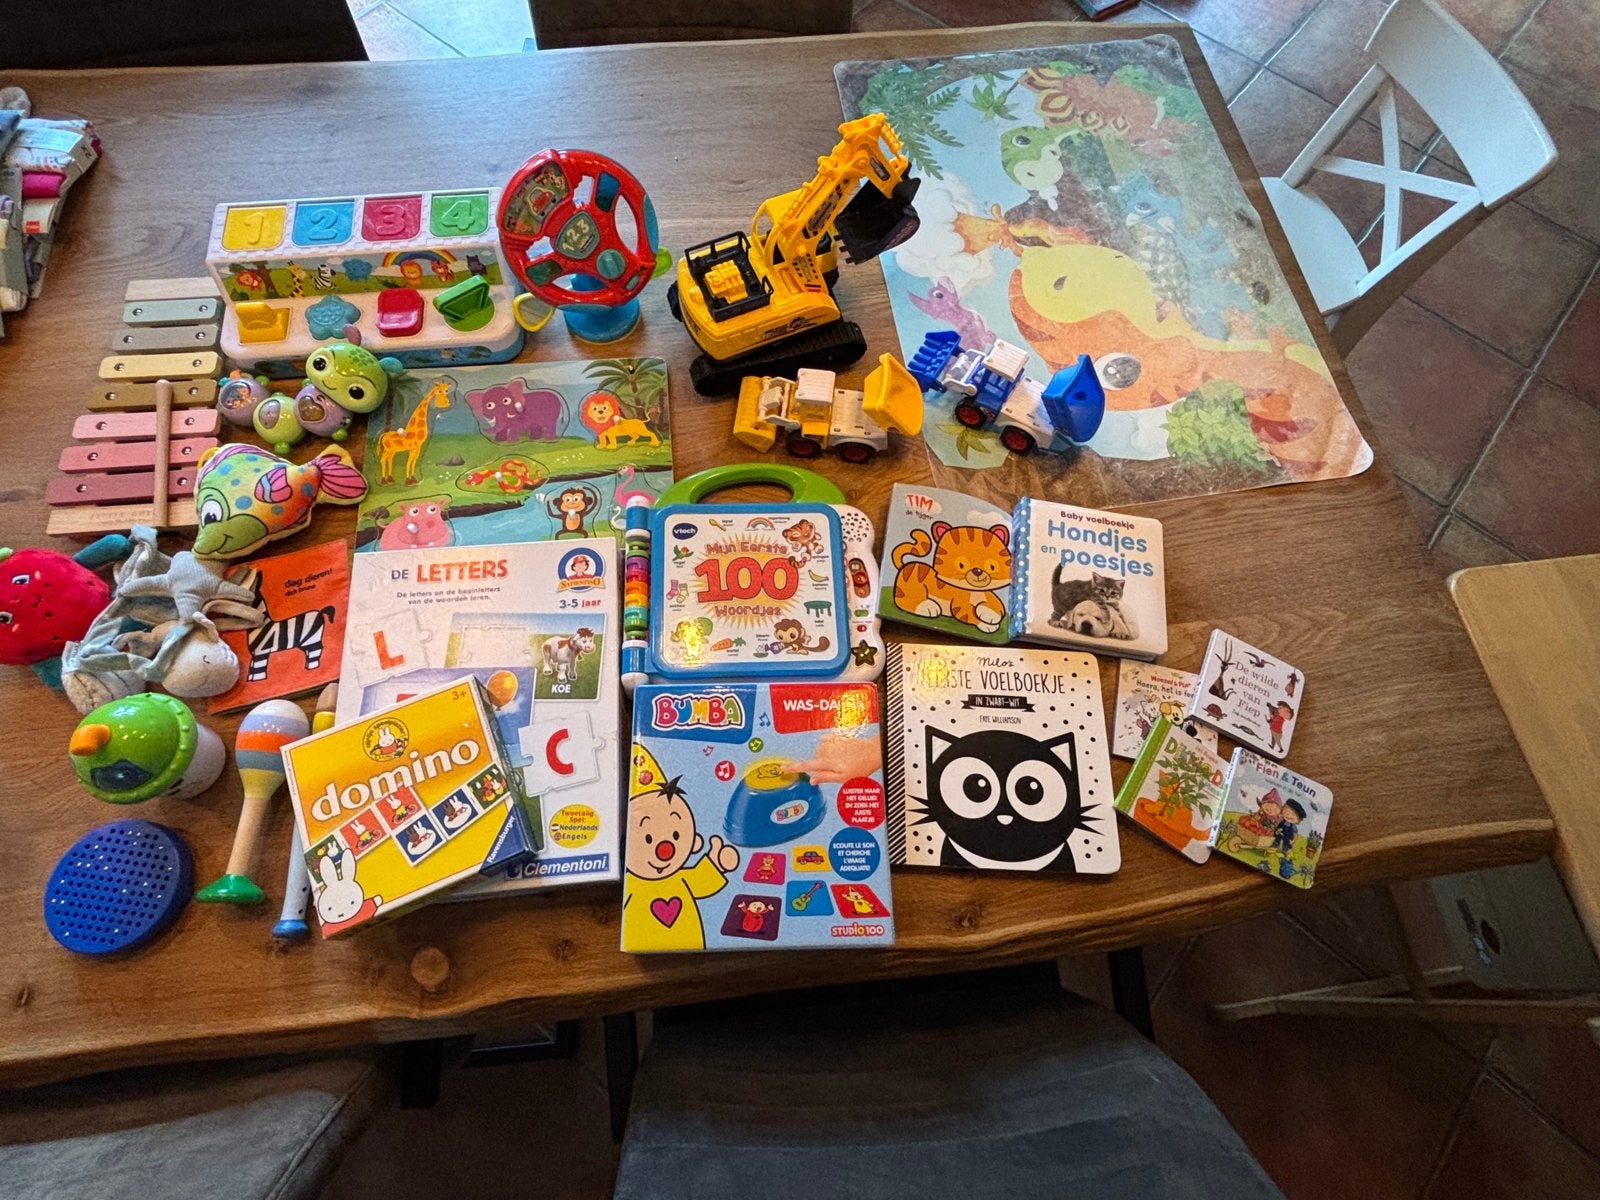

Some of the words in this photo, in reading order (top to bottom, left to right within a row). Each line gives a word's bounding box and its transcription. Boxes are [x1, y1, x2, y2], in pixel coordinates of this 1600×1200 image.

[308, 208, 338, 240] 2
[375, 203, 406, 235] 3
[441, 200, 475, 231] 4
[243, 212, 264, 244] 1
[906, 494, 933, 511] TIM
[1060, 510, 1083, 521] Baby
[1086, 517, 1135, 530] voelboekje
[1048, 519, 1147, 553] Hondjes
[391, 569, 409, 580] DE
[417, 559, 508, 583] LETTERS
[1041, 545, 1057, 554] en
[1060, 548, 1154, 577] poesjes
[284, 579, 303, 588] dag
[304, 567, 333, 583] dieren!
[694, 556, 799, 603] 100
[559, 599, 578, 609] 3-5
[582, 599, 601, 608] jaar
[715, 605, 781, 617] Woordjes
[373, 631, 405, 670] L
[980, 670, 1066, 693] VOELBOEKJE
[1235, 661, 1250, 675] De
[1252, 671, 1280, 690] wilde
[1238, 676, 1270, 698] dieren
[451, 690, 467, 701] 3+
[551, 684, 571, 694] KOE
[1161, 685, 1174, 694] het
[1242, 691, 1261, 706] van
[654, 695, 743, 730] BUMBA
[975, 697, 983, 705] IN
[1237, 699, 1261, 718] Fiep
[545, 727, 575, 776] C
[311, 739, 480, 821] domino
[1256, 762, 1280, 779] Fien
[1281, 771, 1290, 783] &
[1291, 775, 1317, 798] Teun
[486, 816, 516, 863] Ravensburger
[524, 856, 608, 876] Clementoni
[865, 924, 885, 936] 100
